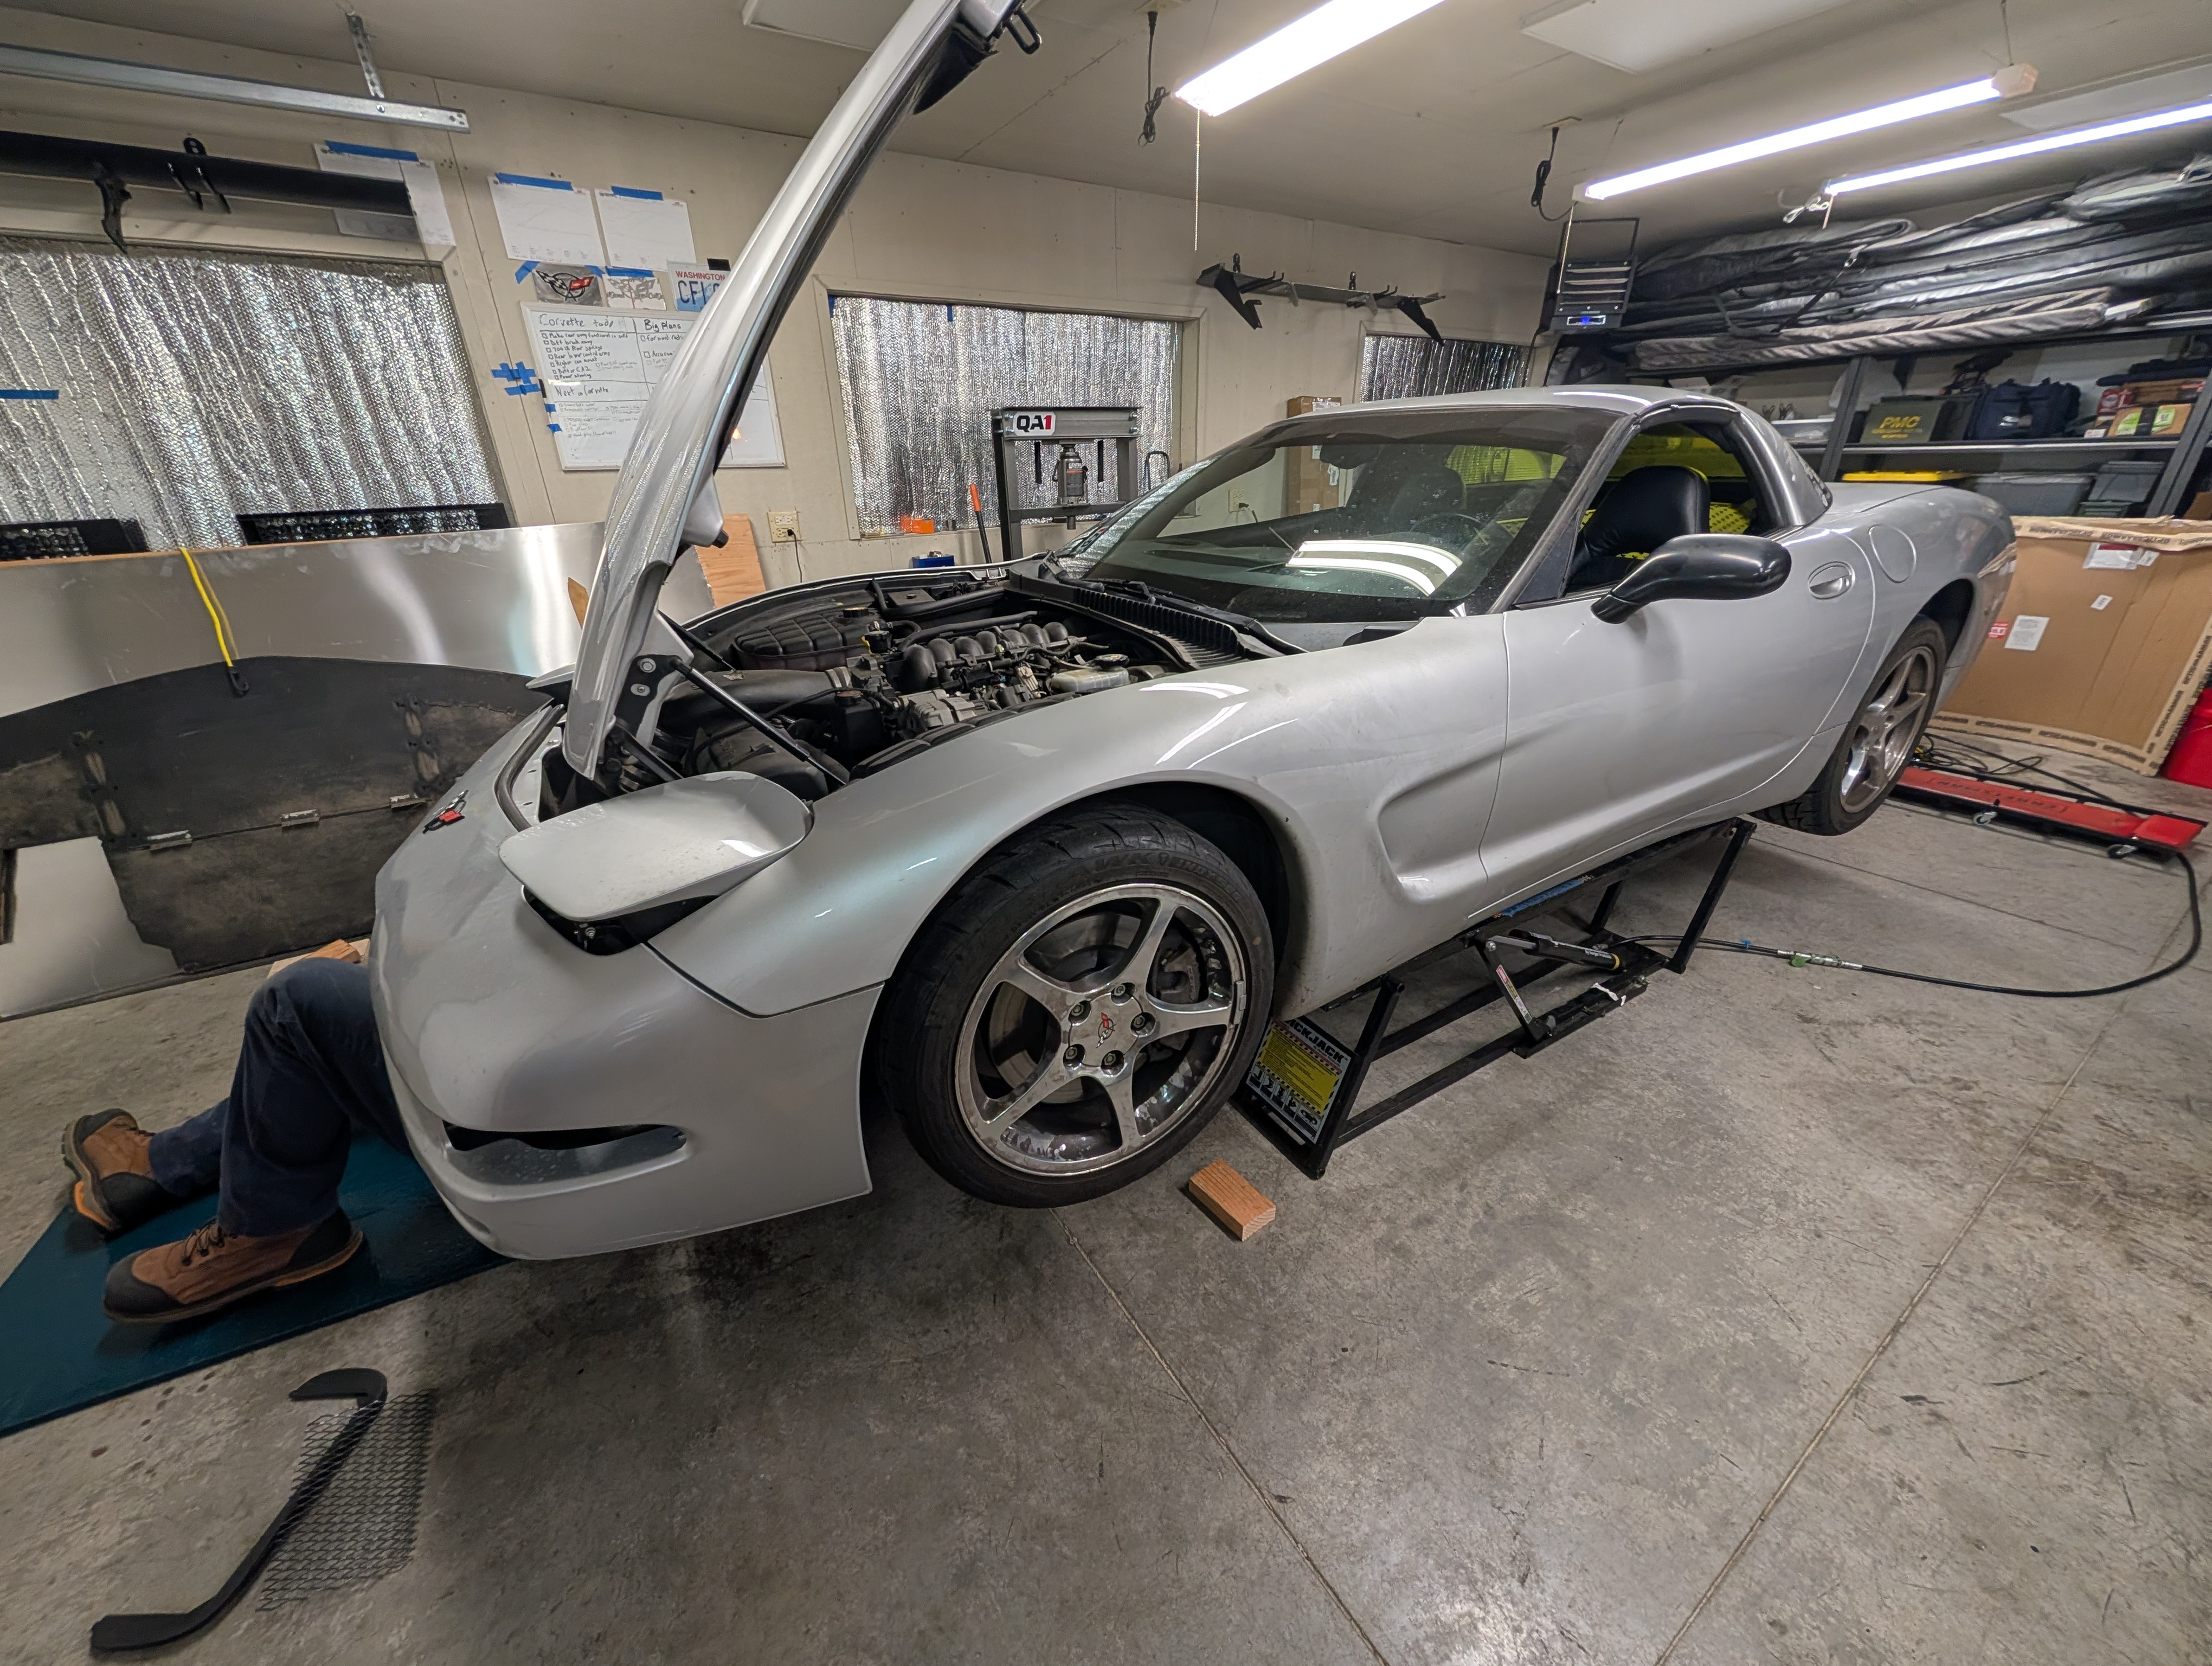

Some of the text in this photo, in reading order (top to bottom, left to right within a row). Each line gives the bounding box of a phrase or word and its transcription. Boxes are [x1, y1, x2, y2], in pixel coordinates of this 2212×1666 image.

[676, 271, 725, 281] WASHINGTON
[539, 313, 585, 327] Corvette
[644, 319, 660, 332] Big
[554, 386, 574, 396] Next
[1016, 415, 1052, 433] QA1
[1879, 415, 1921, 429] PMC
[1284, 1019, 1345, 1064] ICKJACK
